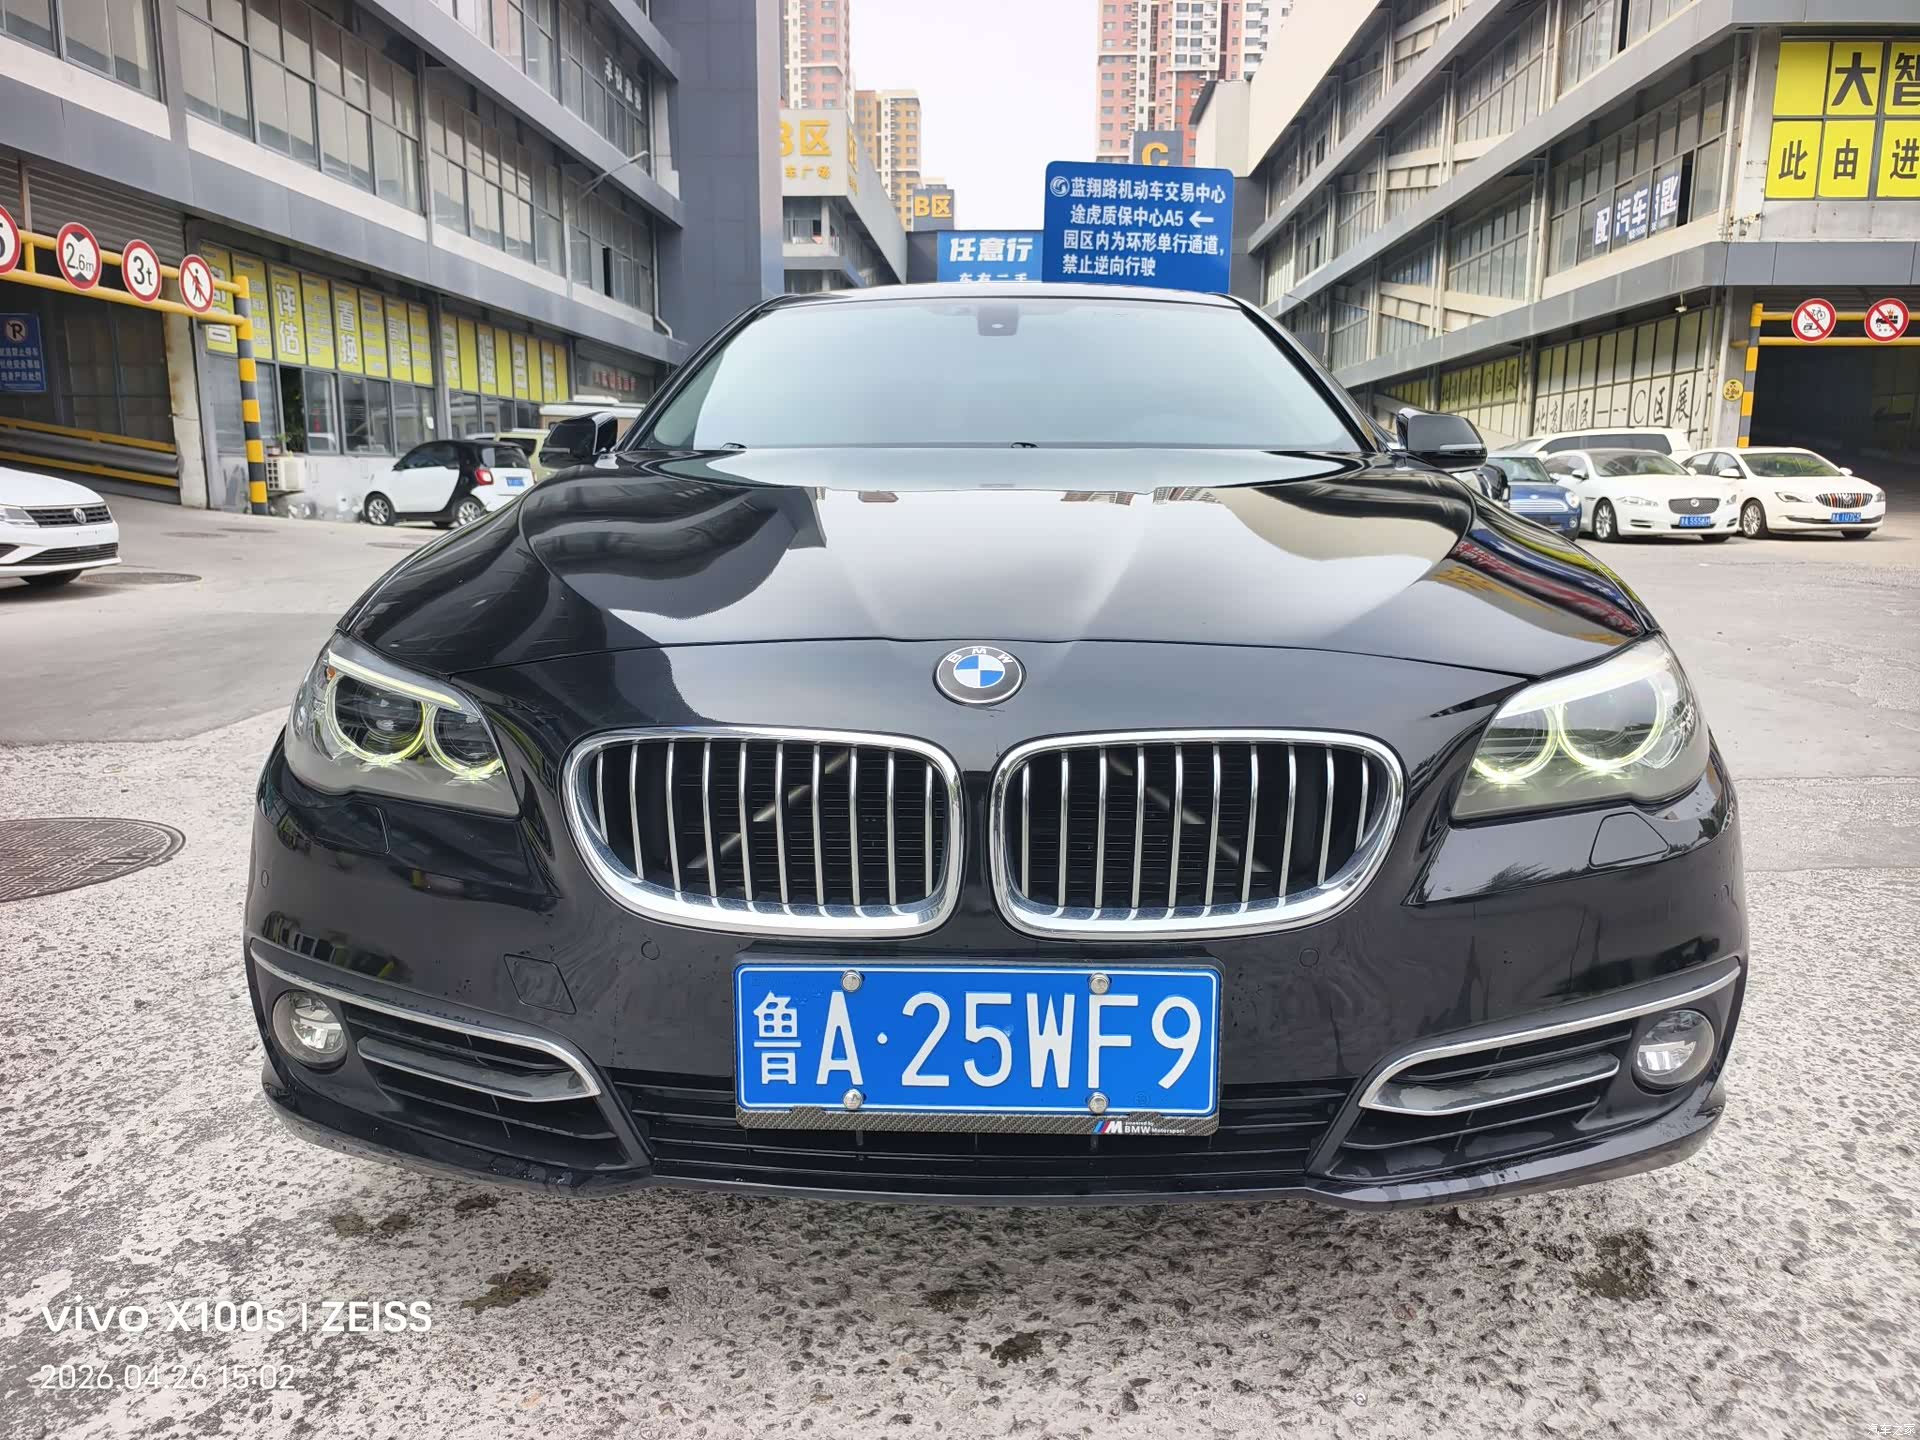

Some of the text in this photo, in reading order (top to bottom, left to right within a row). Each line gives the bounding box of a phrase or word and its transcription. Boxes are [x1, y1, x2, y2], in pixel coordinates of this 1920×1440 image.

[1141, 142, 1169, 167] C
[1778, 137, 1920, 180] 此由进
[1070, 177, 1226, 204] 蓝翔路机动车交易中心
[914, 194, 952, 218] B区
[65, 242, 95, 273] 2.6m
[949, 237, 1033, 262] 任意行
[1062, 253, 1156, 277] 禁止逆向行驶
[946, 647, 1014, 664] BMW
[753, 990, 1202, 1090] 鲁A·25WF9
[1124, 1126, 1151, 1134] BMW
